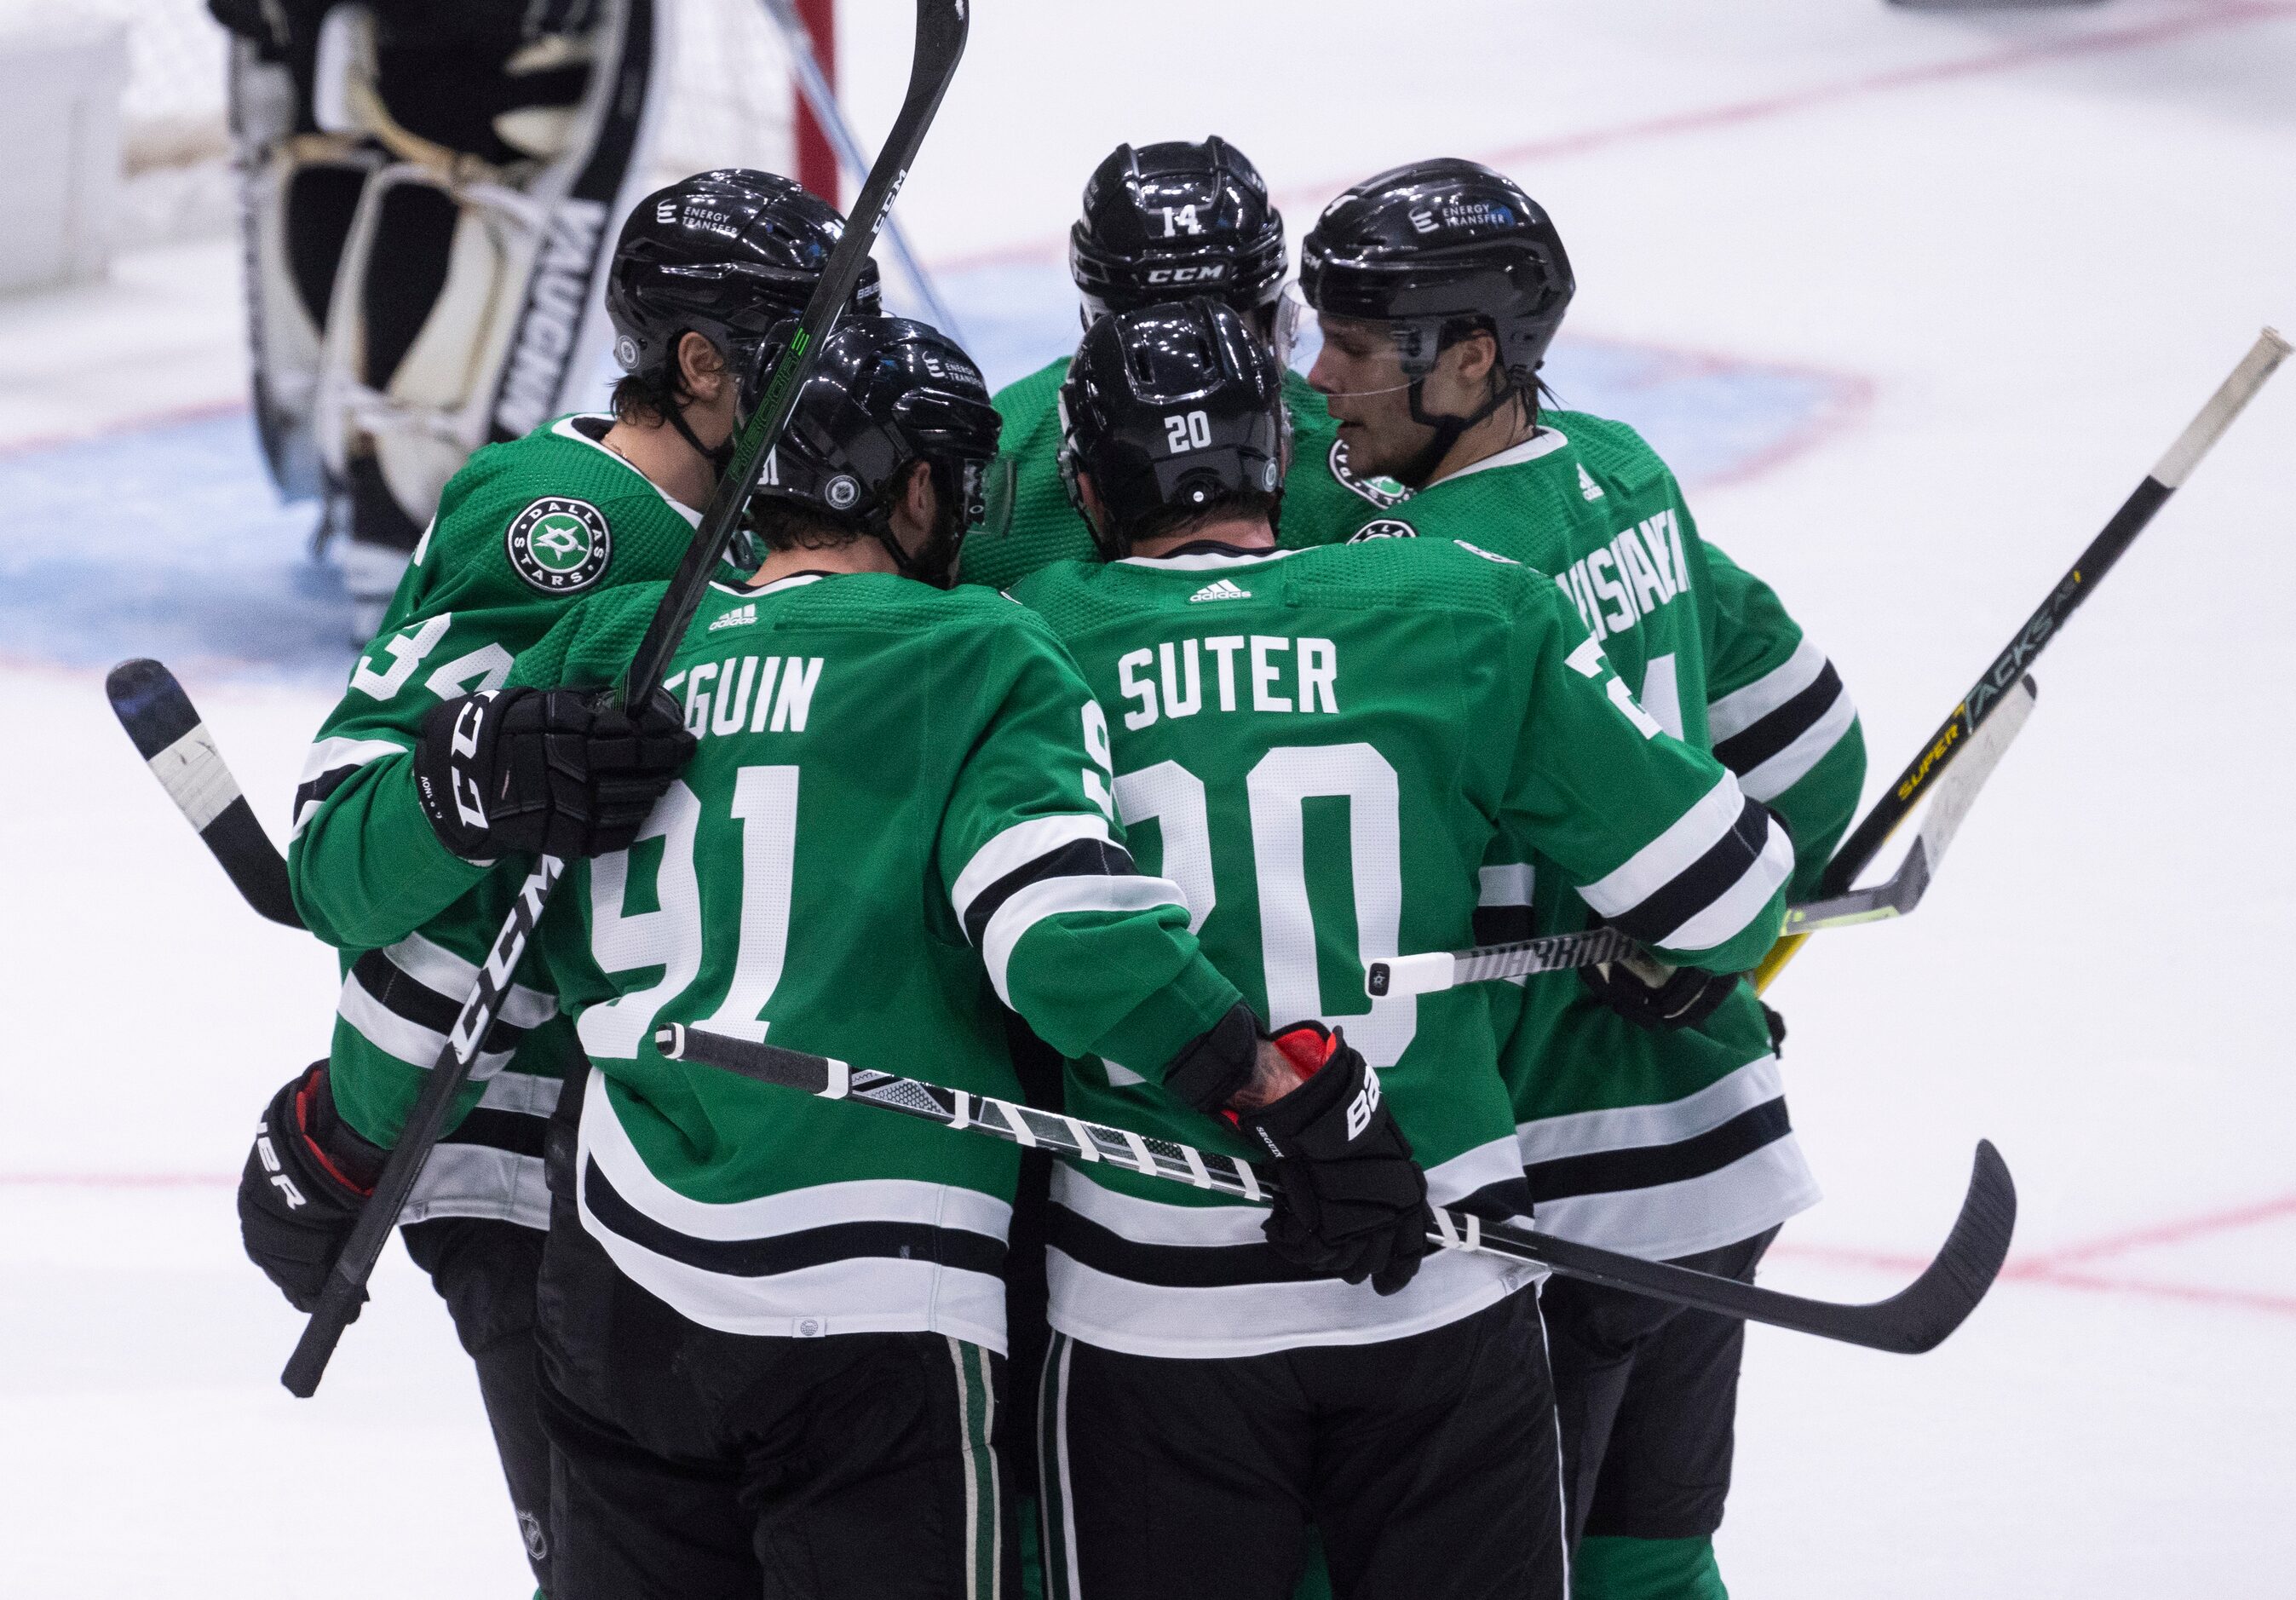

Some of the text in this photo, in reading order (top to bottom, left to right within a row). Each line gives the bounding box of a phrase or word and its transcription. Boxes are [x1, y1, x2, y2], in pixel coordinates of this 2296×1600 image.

[684, 206, 730, 222] ENERGY
[872, 169, 907, 234] CCM
[1161, 204, 1203, 237] 14
[1443, 204, 1489, 217] ENERGY
[1445, 214, 1505, 227] TRANSFER
[682, 216, 739, 236] TRANSFER
[1148, 265, 1224, 283] CCM
[1165, 411, 1211, 453] 20
[528, 503, 604, 558] DALLAS
[515, 537, 583, 586] STARS
[1189, 590, 1252, 601] adidas
[709, 617, 758, 630] adidas
[664, 656, 824, 740] GUIN
[1118, 636, 1340, 730] SUTER
[1898, 724, 1959, 800] SUPER
[1959, 612, 2054, 735] TACKS
[452, 689, 500, 830] CC
[577, 764, 800, 1060] 91
[446, 854, 565, 1064] CCM
[1256, 1126, 1285, 1158] SEGUIN
